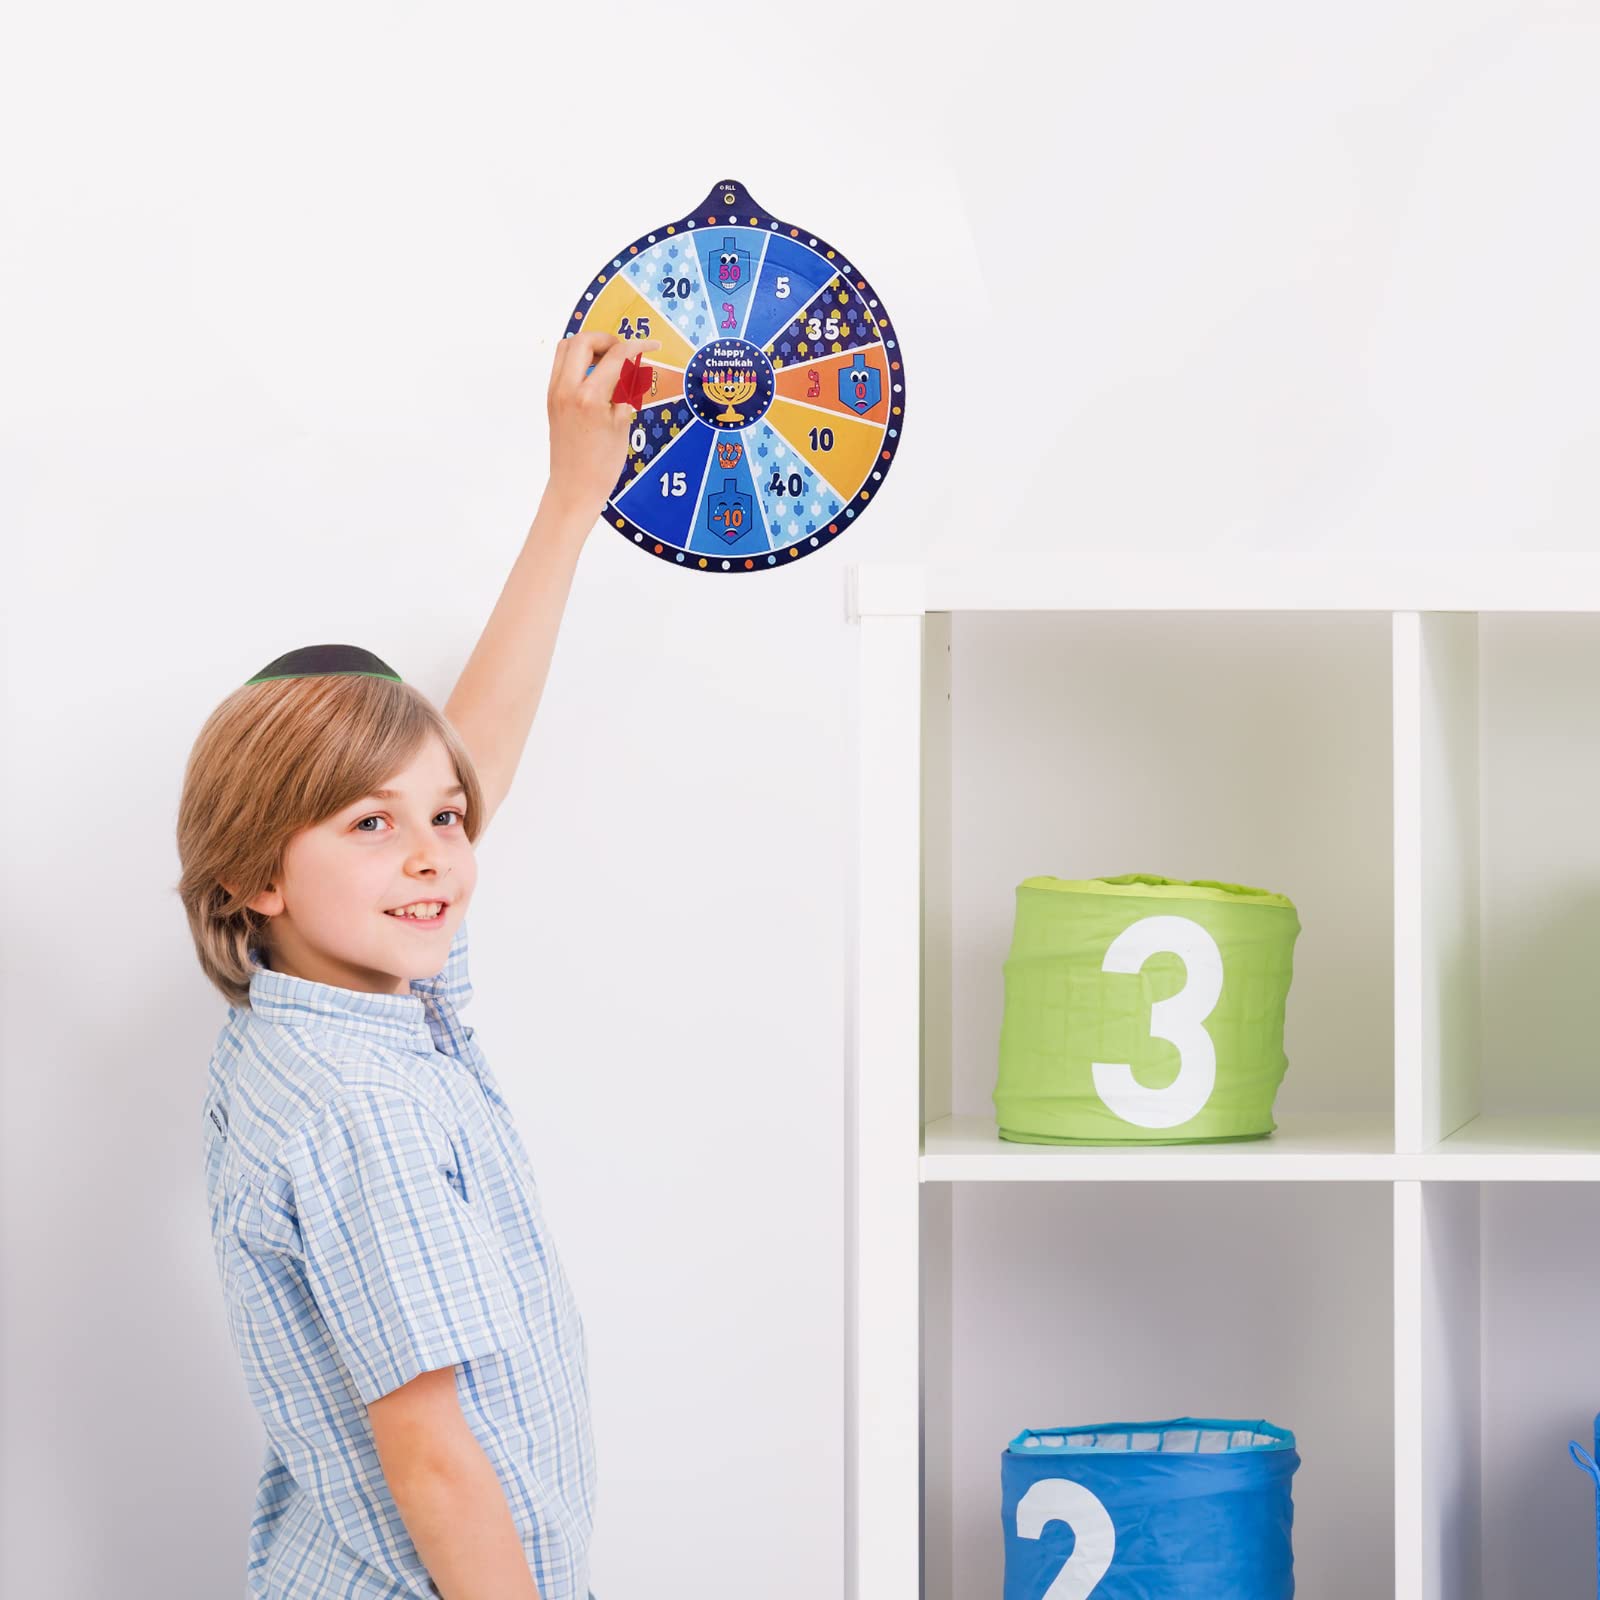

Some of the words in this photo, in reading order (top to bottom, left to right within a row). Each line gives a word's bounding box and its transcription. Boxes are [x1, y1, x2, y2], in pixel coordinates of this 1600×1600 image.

[719, 265, 741, 281] 50
[662, 277, 692, 299] 20
[775, 276, 791, 299] 5
[618, 317, 650, 340] 45
[807, 318, 840, 340] 35
[705, 358, 753, 368] Chanukah
[714, 348, 745, 358] Happy
[855, 382, 867, 399] 0
[631, 428, 646, 452] 0
[808, 427, 834, 451] 10
[659, 472, 687, 497] 15
[769, 472, 803, 497] 40
[713, 509, 743, 527] -10
[1091, 914, 1224, 1129] 3
[1016, 1478, 1116, 1600] 2
